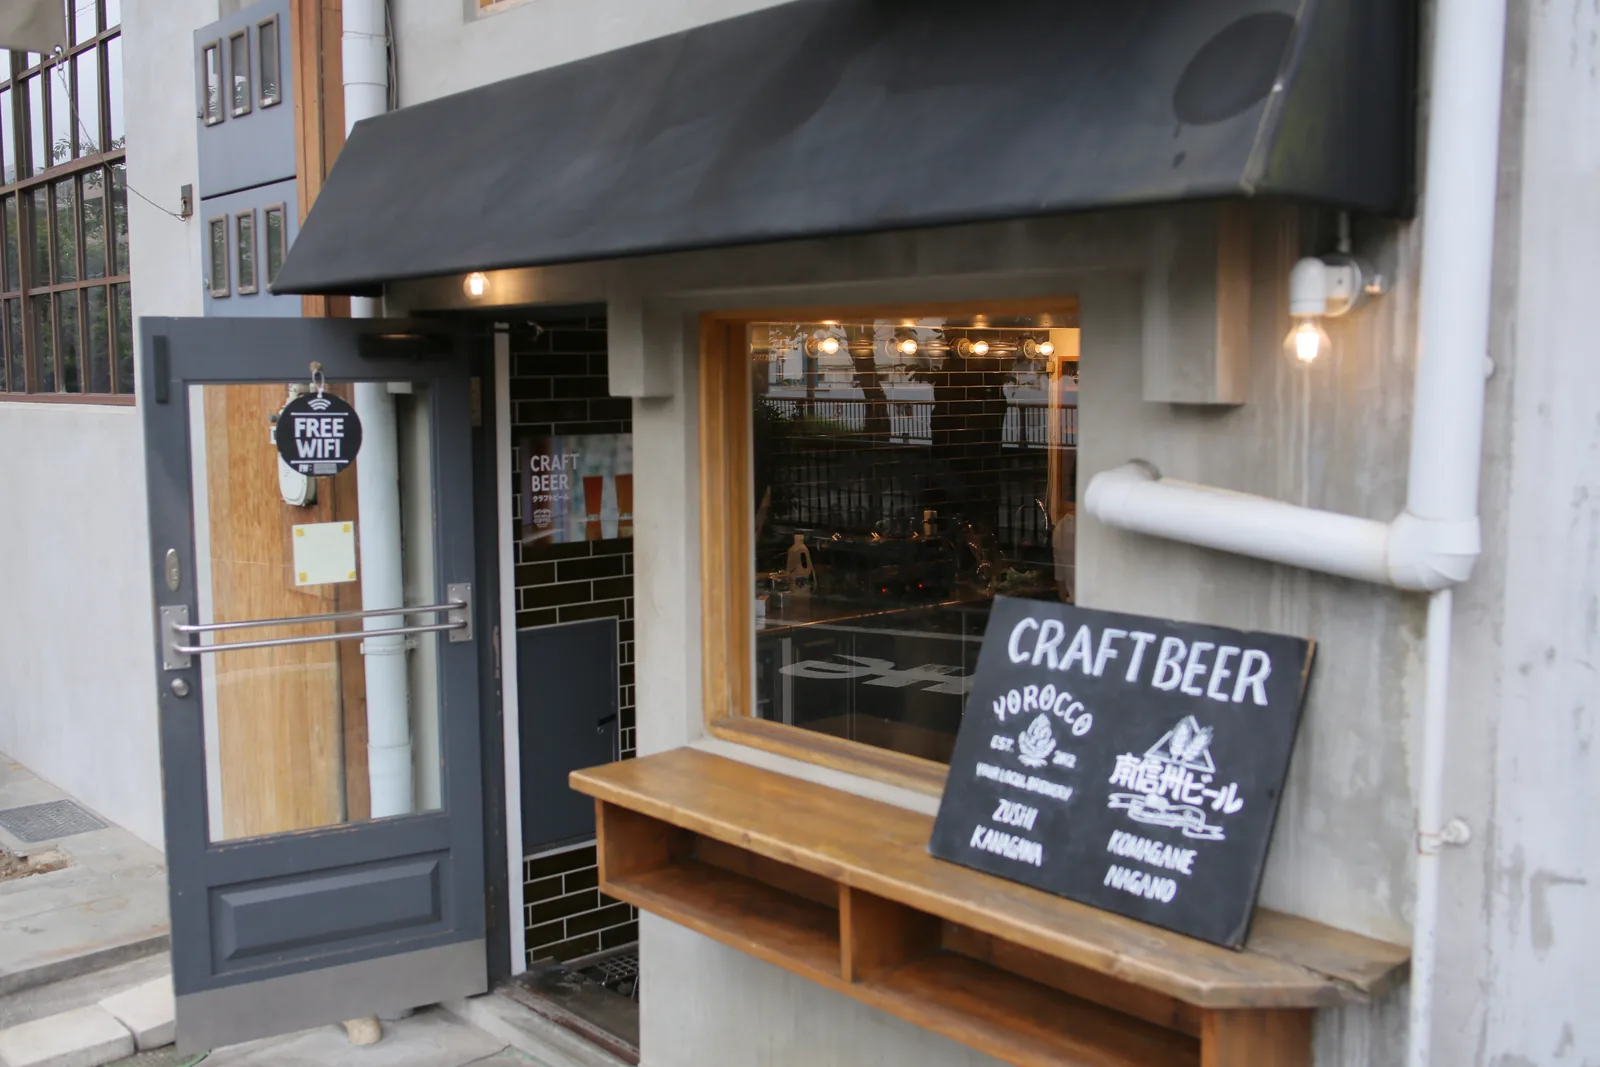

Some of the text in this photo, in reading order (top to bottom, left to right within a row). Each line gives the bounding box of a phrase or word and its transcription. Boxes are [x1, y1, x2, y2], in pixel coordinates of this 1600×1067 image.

[294, 418, 344, 438] FREE
[296, 438, 340, 458] WIFI
[530, 453, 580, 473] CRAFT
[531, 474, 570, 493] BEER
[1007, 617, 1156, 683] CRAFT
[1151, 636, 1272, 706] BEER
[992, 684, 1093, 737] YOROCCO
[1108, 752, 1244, 814] 南信州ビール
[992, 799, 1039, 831] ZUSHI
[1103, 864, 1177, 903] NAGANO
